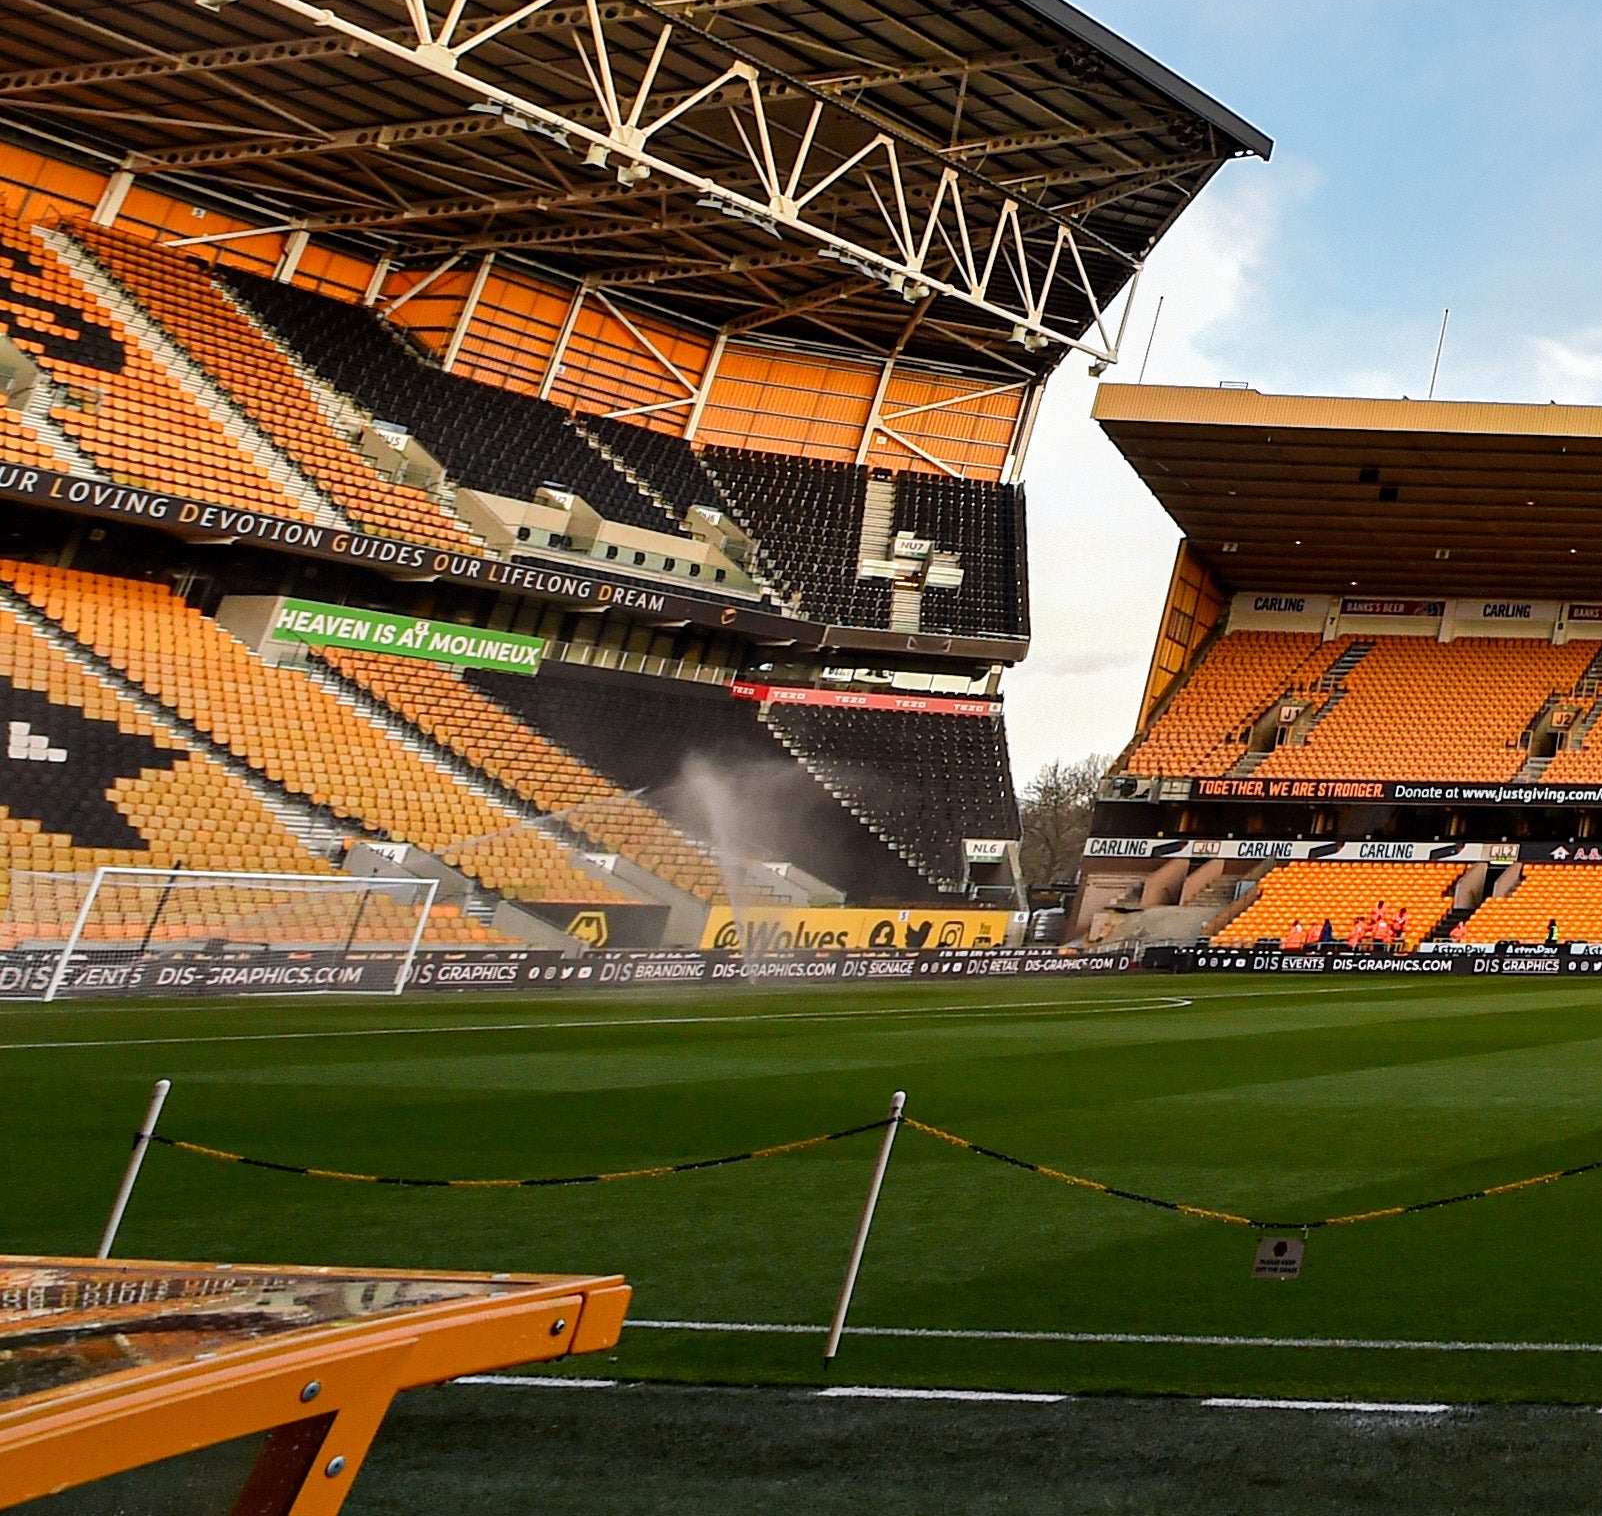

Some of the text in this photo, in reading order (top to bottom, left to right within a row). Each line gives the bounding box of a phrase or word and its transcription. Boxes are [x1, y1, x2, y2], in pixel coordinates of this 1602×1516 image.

[50, 477, 170, 518] LOVING
[178, 502, 323, 548] DEVOTION
[332, 534, 426, 568] GUIDES
[433, 553, 481, 578] OUR
[487, 567, 592, 598] LIFELONG
[598, 584, 665, 612] DREAM
[900, 542, 924, 551] NU7
[1254, 598, 1306, 612] CARLING
[1383, 602, 1405, 613] BEER
[1483, 604, 1531, 618] CARLING
[276, 608, 541, 666] HEAVEN IS AT MOLINEUX
[733, 686, 754, 695] TEZO
[773, 690, 806, 700] TEZO
[835, 695, 867, 705] TEZO
[896, 699, 927, 709] TEZO
[953, 703, 984, 713] TEZO
[1284, 707, 1299, 720] J1
[1556, 714, 1571, 725] J2
[1199, 781, 1385, 798] TOGETHER, WE ARE STRONGER.
[1395, 785, 1442, 799] Donate
[1445, 788, 1458, 799] at
[973, 843, 997, 853] NL6
[1090, 840, 1148, 855] CARLING
[1238, 842, 1293, 857] CARLING
[1359, 844, 1413, 859] CARLING
[714, 920, 848, 948] @Wolves
[842, 961, 867, 978] DIS
[967, 959, 988, 975] DIS
[1253, 957, 1325, 971] DIS EVENTS
[1332, 959, 1453, 972] DIS-GRAPHICS.COM
[1474, 959, 1560, 973] DIS GRAPHICS
[437, 965, 519, 981] GRAPHICS
[599, 962, 705, 982] DIS BRANDING
